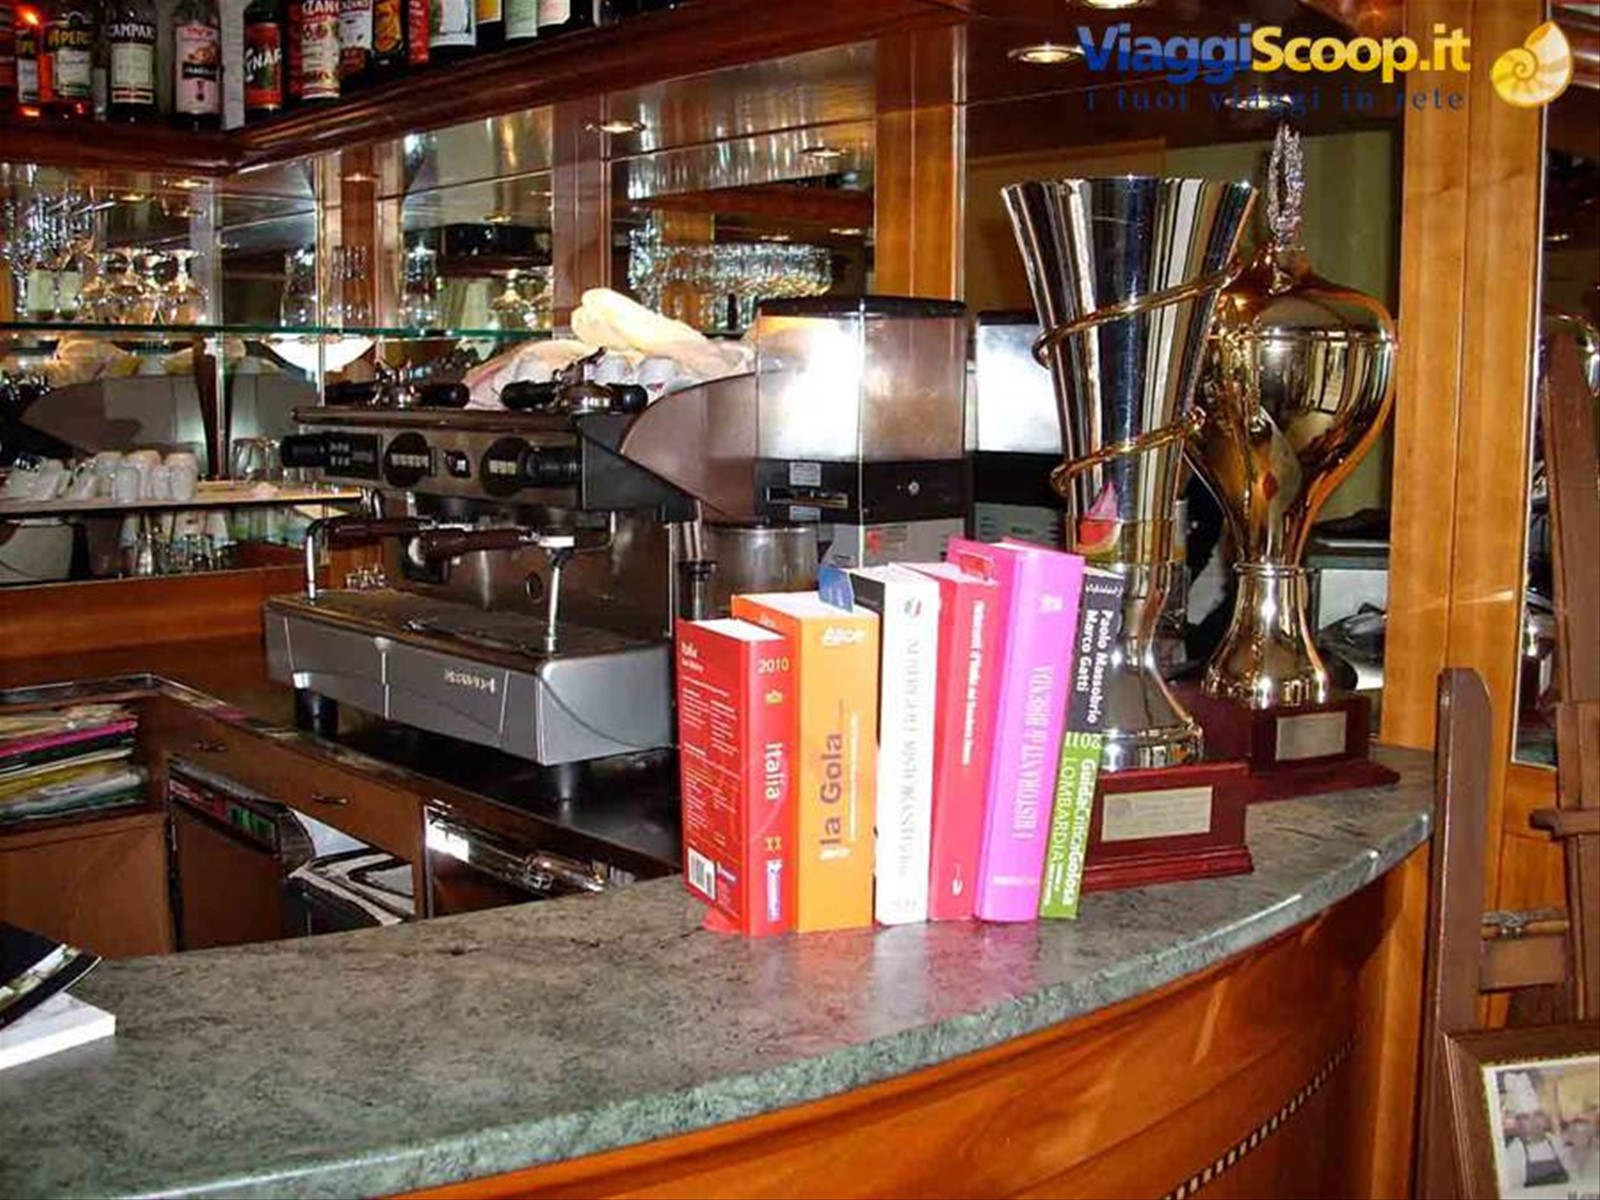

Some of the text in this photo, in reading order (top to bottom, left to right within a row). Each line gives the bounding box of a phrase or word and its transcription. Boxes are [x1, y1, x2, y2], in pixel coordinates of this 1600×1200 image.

[1076, 609, 1098, 692] Marco Gatti
[1097, 609, 1114, 649] Paolo
[757, 656, 790, 676] 2010
[1087, 651, 1108, 724] Massobrio
[819, 733, 843, 804] Gola
[1065, 731, 1101, 749] 2011
[764, 742, 785, 801] Italia
[819, 816, 842, 845] la
[1052, 757, 1078, 863] LOMBARDIA
